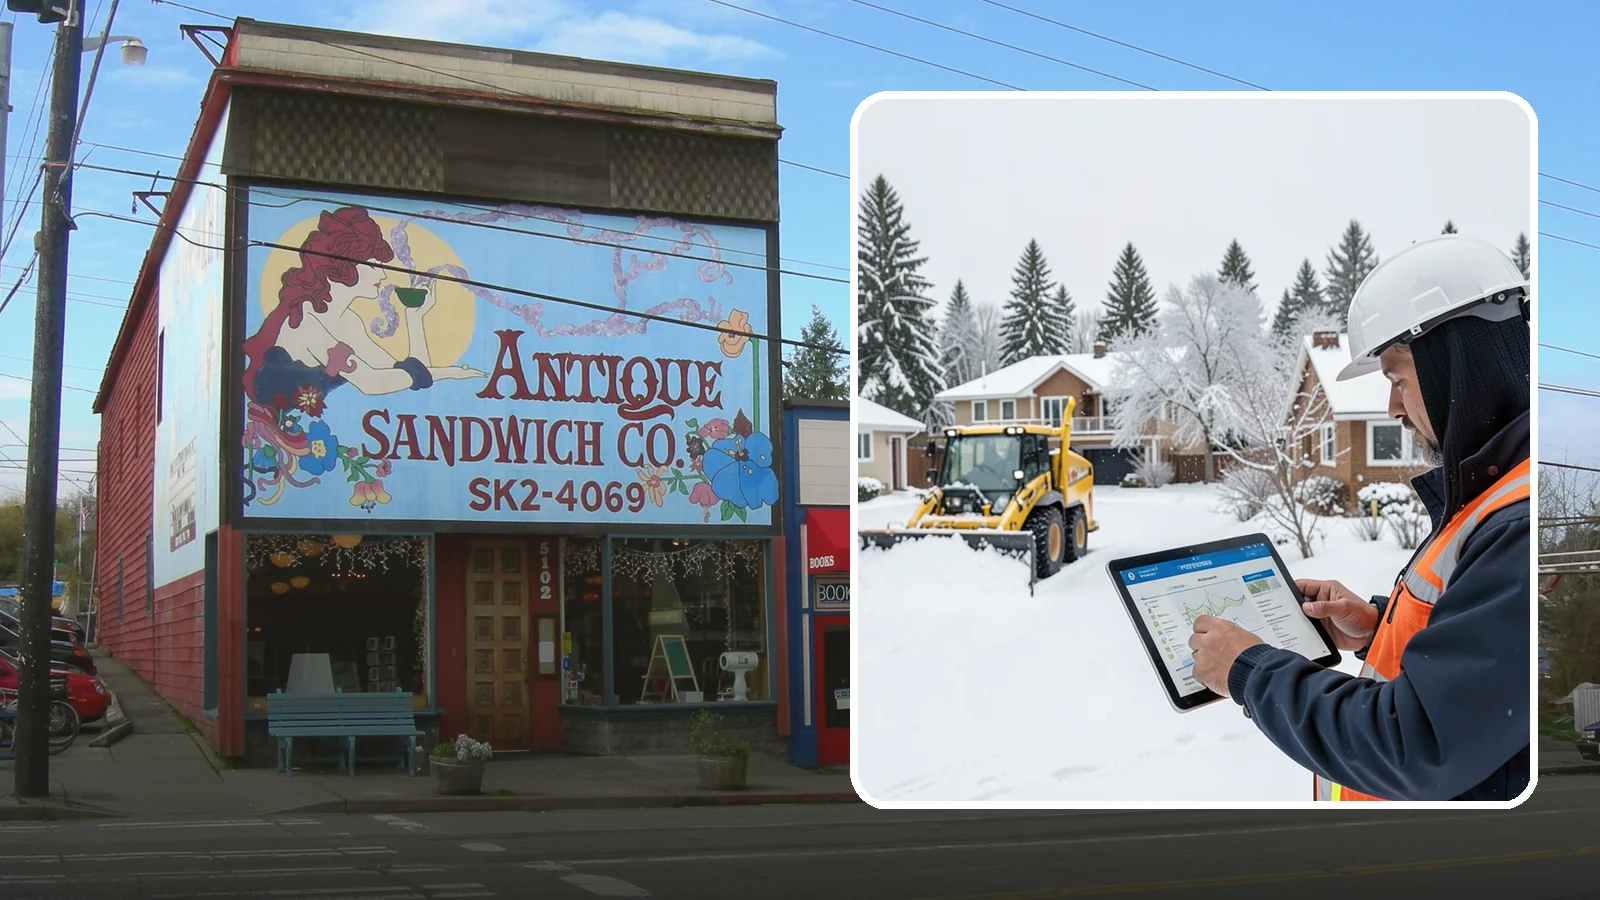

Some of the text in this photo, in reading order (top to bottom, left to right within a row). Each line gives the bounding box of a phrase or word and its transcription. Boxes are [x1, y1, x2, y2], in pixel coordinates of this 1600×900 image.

[476, 329, 723, 420] ANTIQUE
[361, 409, 685, 469] SANDWICH CO.
[468, 477, 646, 513] SK2-4069
[540, 541, 551, 600] 5102
[809, 555, 834, 568] BOOKS
